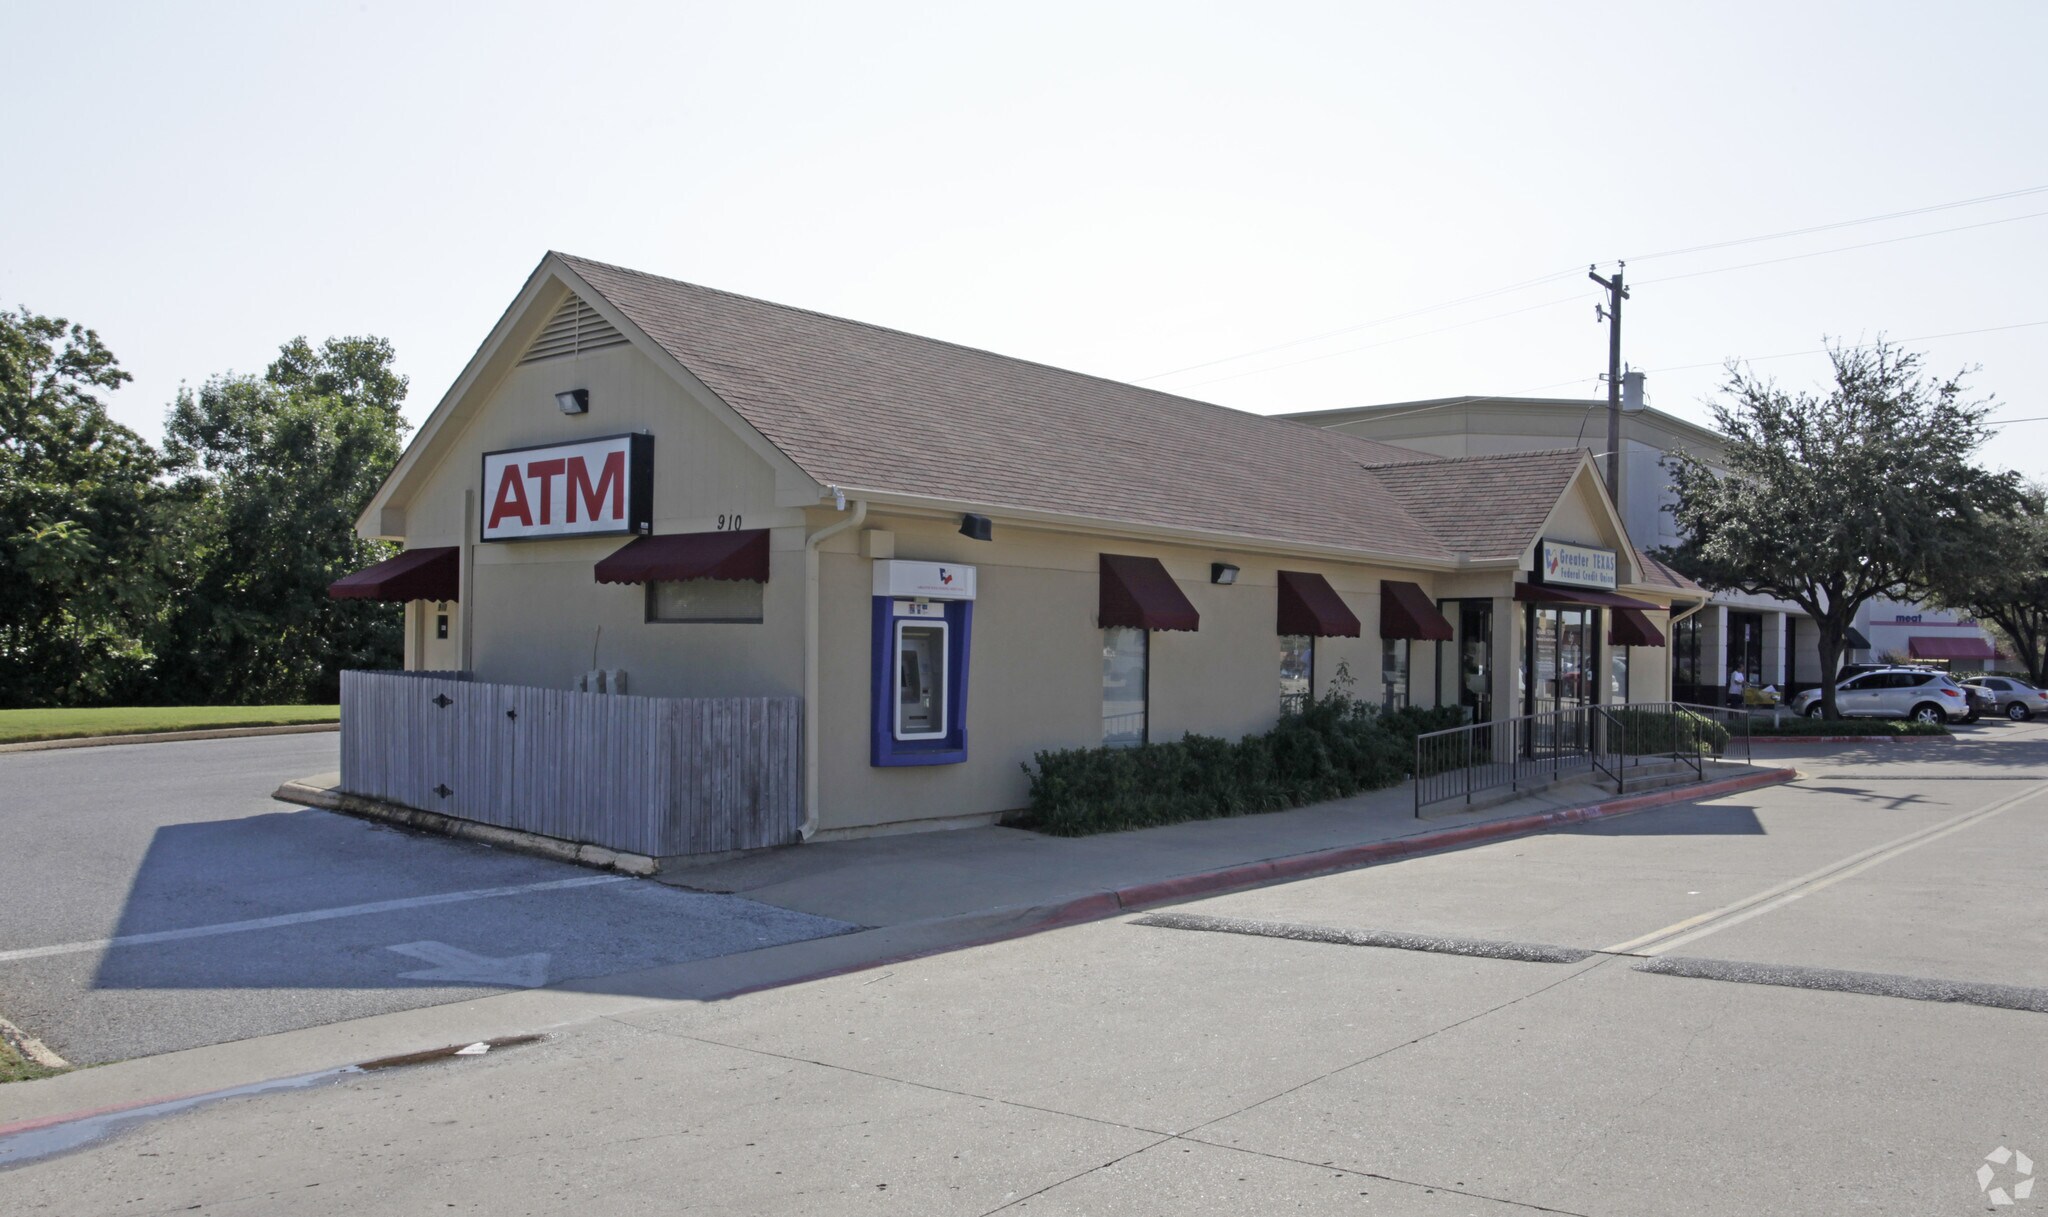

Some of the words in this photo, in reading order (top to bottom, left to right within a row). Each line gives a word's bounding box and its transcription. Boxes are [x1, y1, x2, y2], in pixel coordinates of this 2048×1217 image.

[487, 451, 625, 529] ATM
[717, 514, 742, 532] 910
[1560, 549, 1589, 568] Greater
[1593, 553, 1614, 571] TEXAS
[1560, 568, 1581, 580] Federal
[1582, 570, 1598, 581] Credit
[1600, 572, 1614, 583] Union
[1896, 614, 1922, 623] meat
